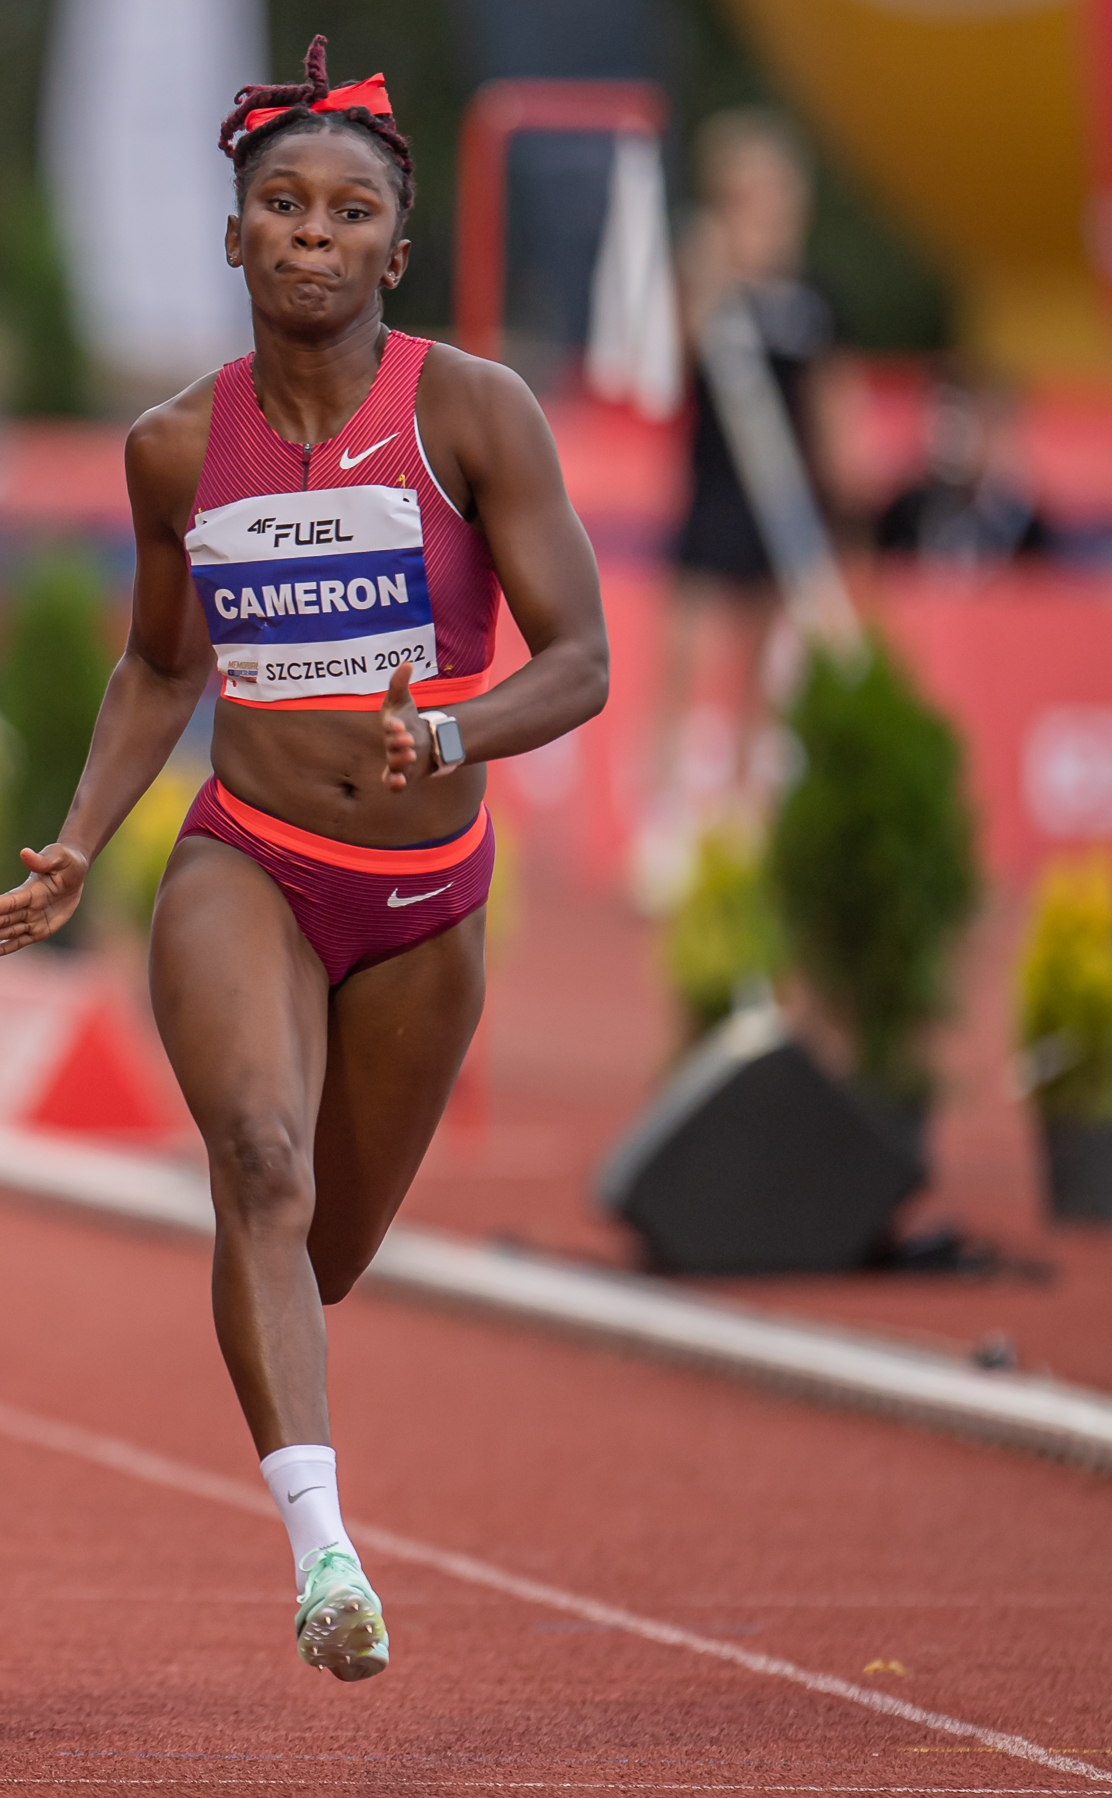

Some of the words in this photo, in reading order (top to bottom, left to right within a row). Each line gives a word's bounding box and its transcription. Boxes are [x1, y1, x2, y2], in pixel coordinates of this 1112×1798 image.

[273, 518, 354, 547] FUEL
[214, 573, 409, 619] CAMERON
[266, 656, 368, 680] SZCZECIN
[374, 644, 426, 671] 2022
